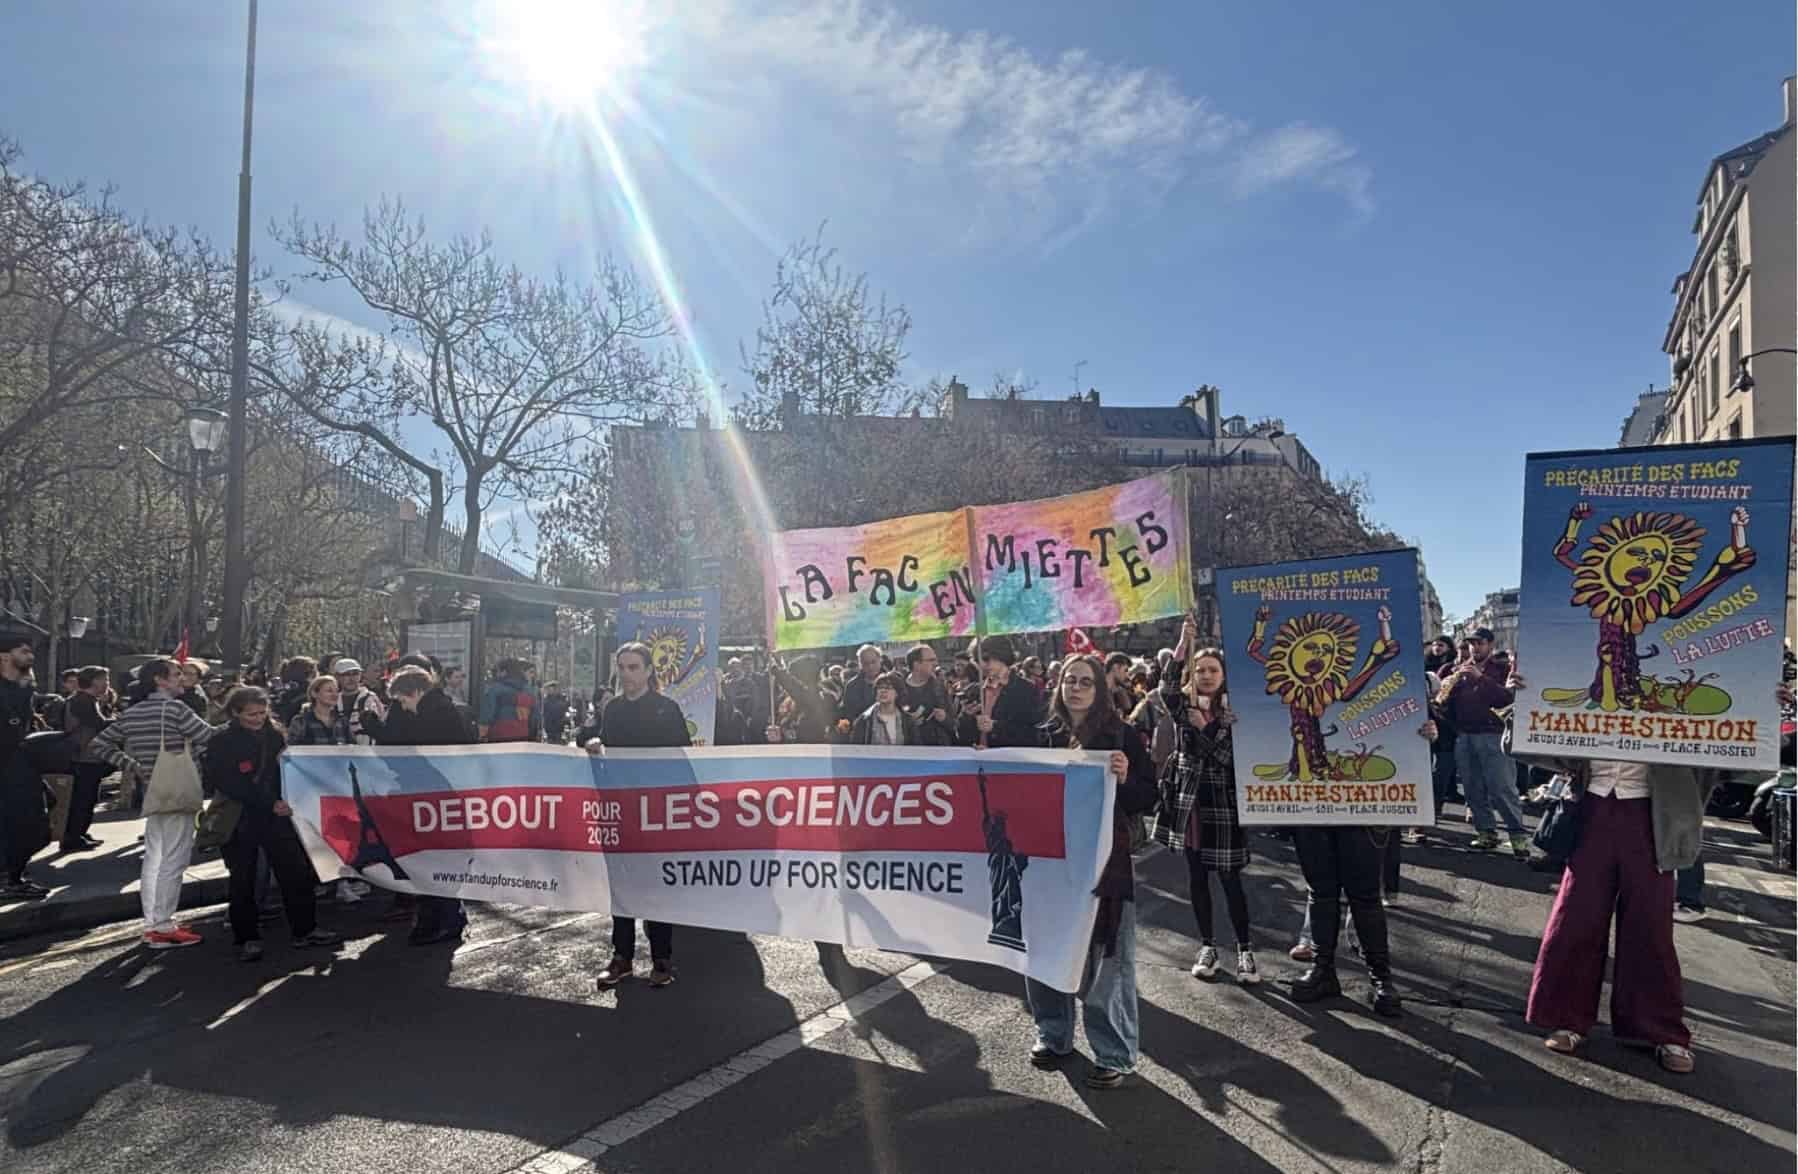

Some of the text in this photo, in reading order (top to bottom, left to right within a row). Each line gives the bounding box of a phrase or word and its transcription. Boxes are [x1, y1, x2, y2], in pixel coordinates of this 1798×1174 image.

[1544, 459, 1741, 487] PRÉCARITÉ DES FACS
[1580, 483, 1665, 498] PRINTEMPS
[778, 511, 1169, 622] LA FAC EN MIETTES
[1311, 571, 1340, 587] DES
[1343, 567, 1380, 584] FACS
[1261, 587, 1327, 601] PRINTEMPS
[1663, 584, 1758, 645] POUSSONS
[1672, 618, 1775, 664] LA LUTTE
[1338, 670, 1406, 721] POUSSONS
[1348, 697, 1420, 740] LA LUTTE
[1529, 711, 1757, 742] MANIFESTATION
[1528, 733, 1558, 745] JEUDI
[1565, 736, 1599, 747] AVRIL
[1662, 742, 1701, 754] PLACE
[1704, 745, 1757, 757] JUSSIEU
[412, 782, 954, 833] DEBOUT POUR LES SCIENCES
[1245, 783, 1417, 803] MANIFESTATION
[587, 827, 620, 846] 2025
[432, 870, 559, 892] www.standupforscience.fr
[662, 859, 964, 894] STAND UP FOR SCIENCE
